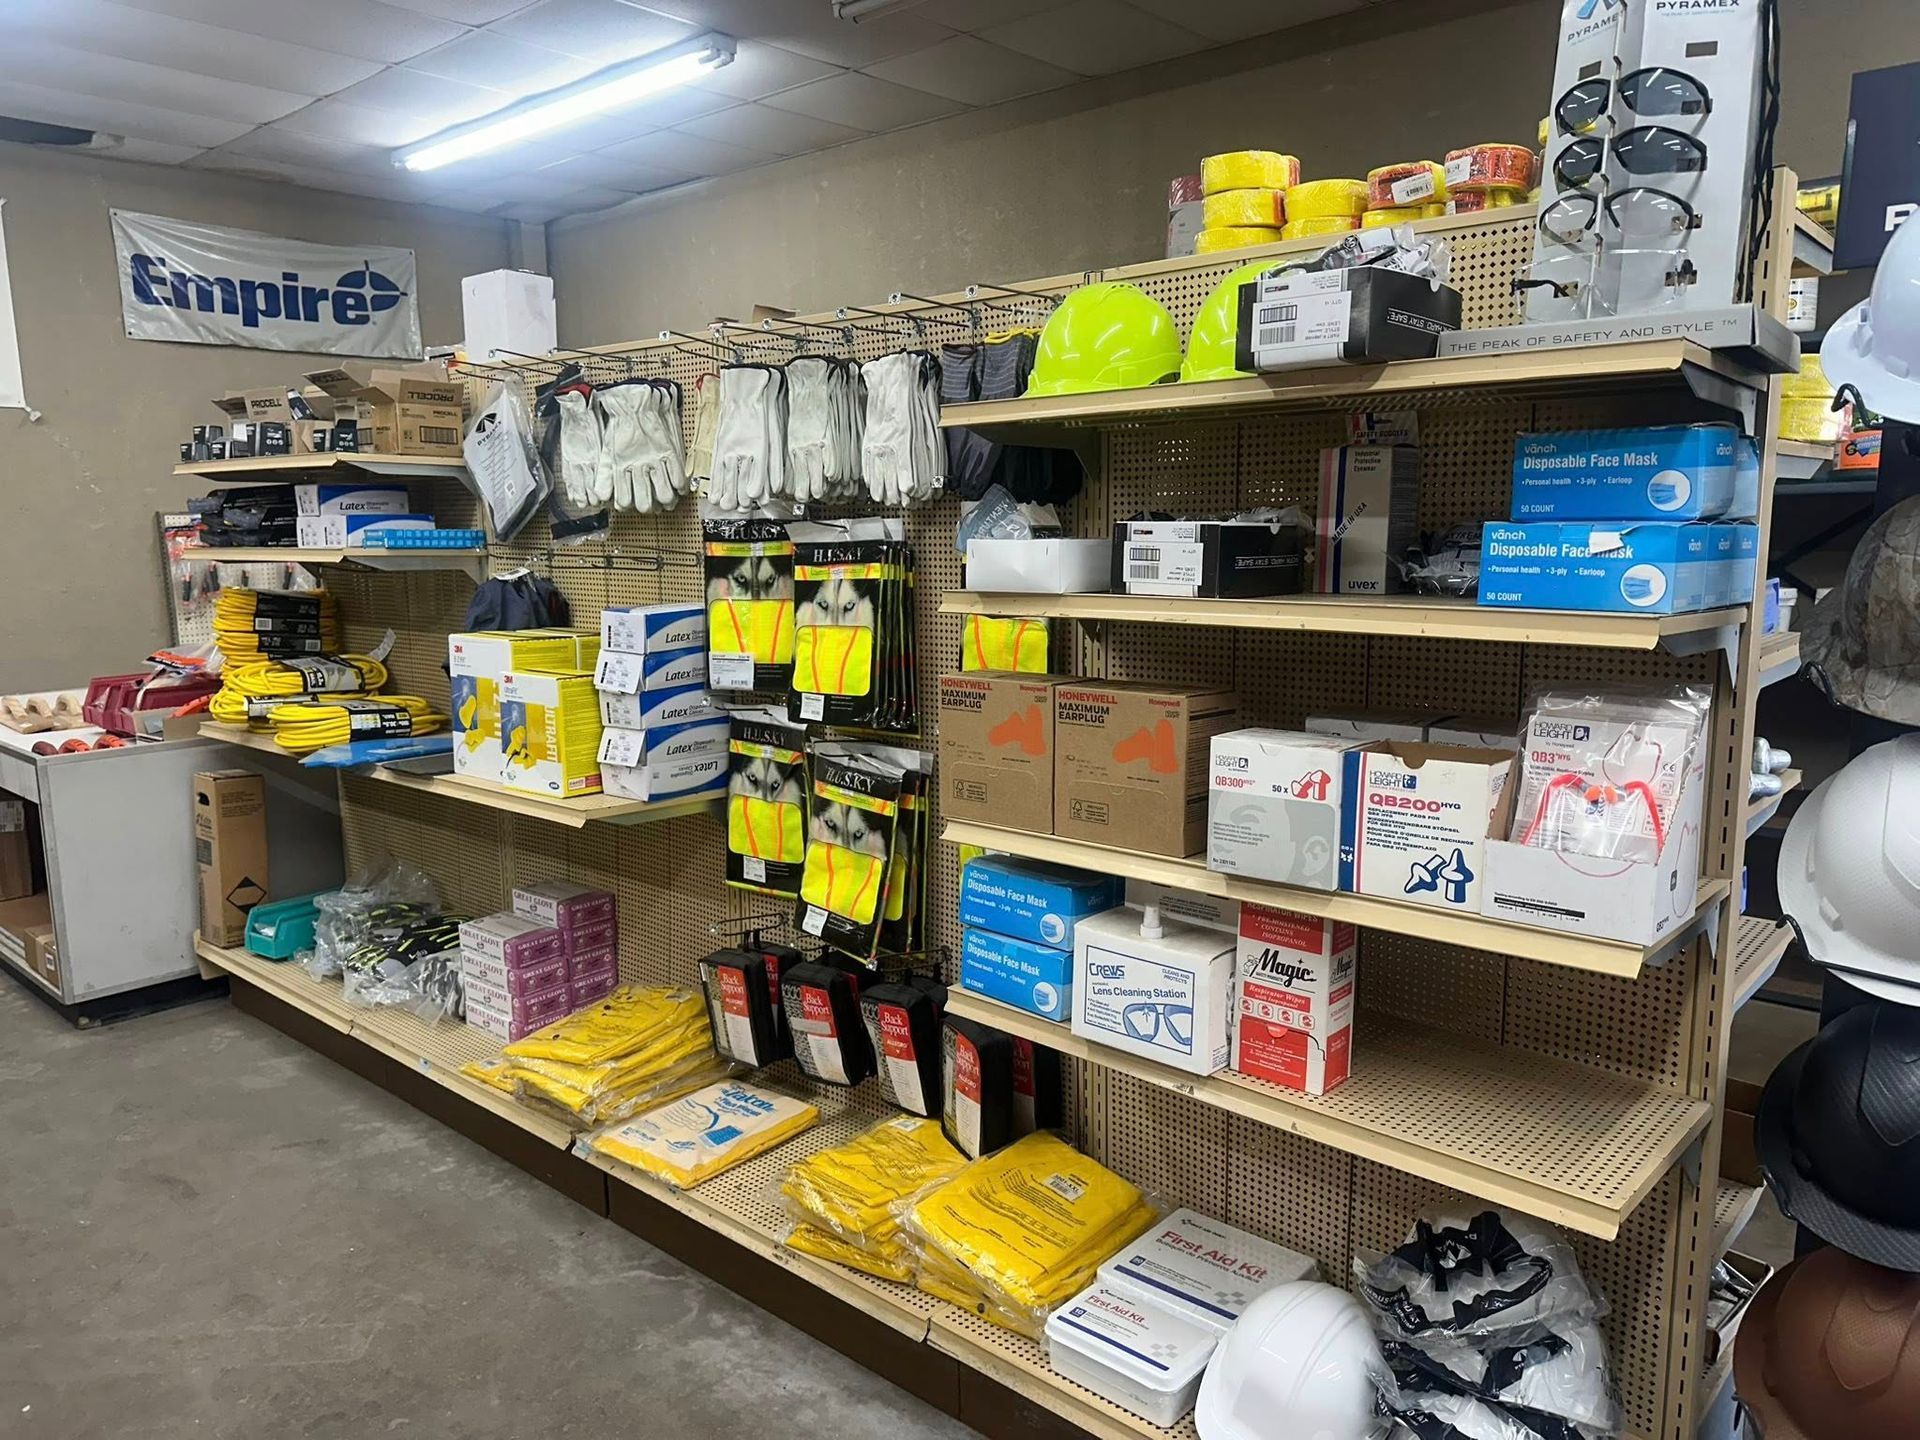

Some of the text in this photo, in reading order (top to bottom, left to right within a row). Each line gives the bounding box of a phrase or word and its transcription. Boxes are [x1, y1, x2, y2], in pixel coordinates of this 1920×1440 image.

[1656, 0, 1740, 11] PYRAMEX
[1567, 10, 1624, 42] PYRAME
[130, 253, 370, 328] Empire
[1409, 317, 1424, 328] STAY
[1450, 321, 1713, 352] THE PEAK OF SAFETY AND STYLE
[251, 398, 282, 408] PROCELL
[1523, 452, 1658, 472] Disposable Face Mask
[1525, 476, 1633, 487] Personal health 3-ply Earloop
[339, 501, 366, 511] Latex
[1521, 504, 1554, 513] 50 COUNT
[1332, 502, 1367, 542] MADE IN USA
[1490, 542, 1592, 560] Disposable Face
[1491, 565, 1605, 577] Personal health 3-ply Earloop
[1348, 580, 1377, 590] uvex
[1486, 592, 1522, 601] 50 COUNT
[665, 633, 691, 643] Latex
[665, 671, 691, 681] Latex
[941, 679, 992, 691] HONEYWELL
[941, 689, 986, 700] MAXIMUM
[1058, 690, 1180, 707] HONEYWELL Honeywell
[942, 698, 982, 709] EARPLUG
[1058, 702, 1110, 716] MAXIMUM
[662, 708, 688, 719] Latex
[1058, 711, 1105, 724] EARPLUG
[1534, 721, 1573, 731] HOWARD
[1534, 730, 1572, 740] LEIGHT
[667, 744, 692, 755] Latex
[694, 761, 718, 772] Latex
[1216, 759, 1238, 767] LEIGHT
[1370, 771, 1402, 779] HOWARD
[1370, 777, 1401, 787] LEIGHT
[1368, 807, 1408, 817] REPLACEMENT
[1441, 837, 1474, 845] RECHANGE
[967, 879, 1047, 908] Disposable Face Mask
[514, 891, 553, 909] GREAT GLOVE
[460, 928, 500, 947] GREAT GLOVE
[1262, 932, 1307, 946] ISOPROPANOL
[464, 955, 503, 976] GREAT GLOVE
[967, 943, 1040, 976] Disposable Face Mask
[1162, 969, 1179, 977] CLEANS
[1250, 948, 1317, 987] Magic
[723, 973, 739, 985] Back
[1164, 975, 1187, 984] PROTECTS
[466, 981, 507, 1002] GREAT GLOVE
[721, 983, 744, 994] Support
[1093, 986, 1186, 999] Lens Cleaning Station
[806, 993, 822, 1006] Back
[1286, 993, 1305, 1003] Wipes
[803, 1003, 829, 1015] Support
[467, 1005, 505, 1027] GREAT GLOVE
[884, 1012, 902, 1026] Back
[881, 1021, 908, 1036] Support
[960, 1044, 974, 1063] Back
[956, 1052, 979, 1075] Support
[1161, 1230, 1268, 1279] First Aid Kit
[1088, 1295, 1145, 1323] First Aid Kit
